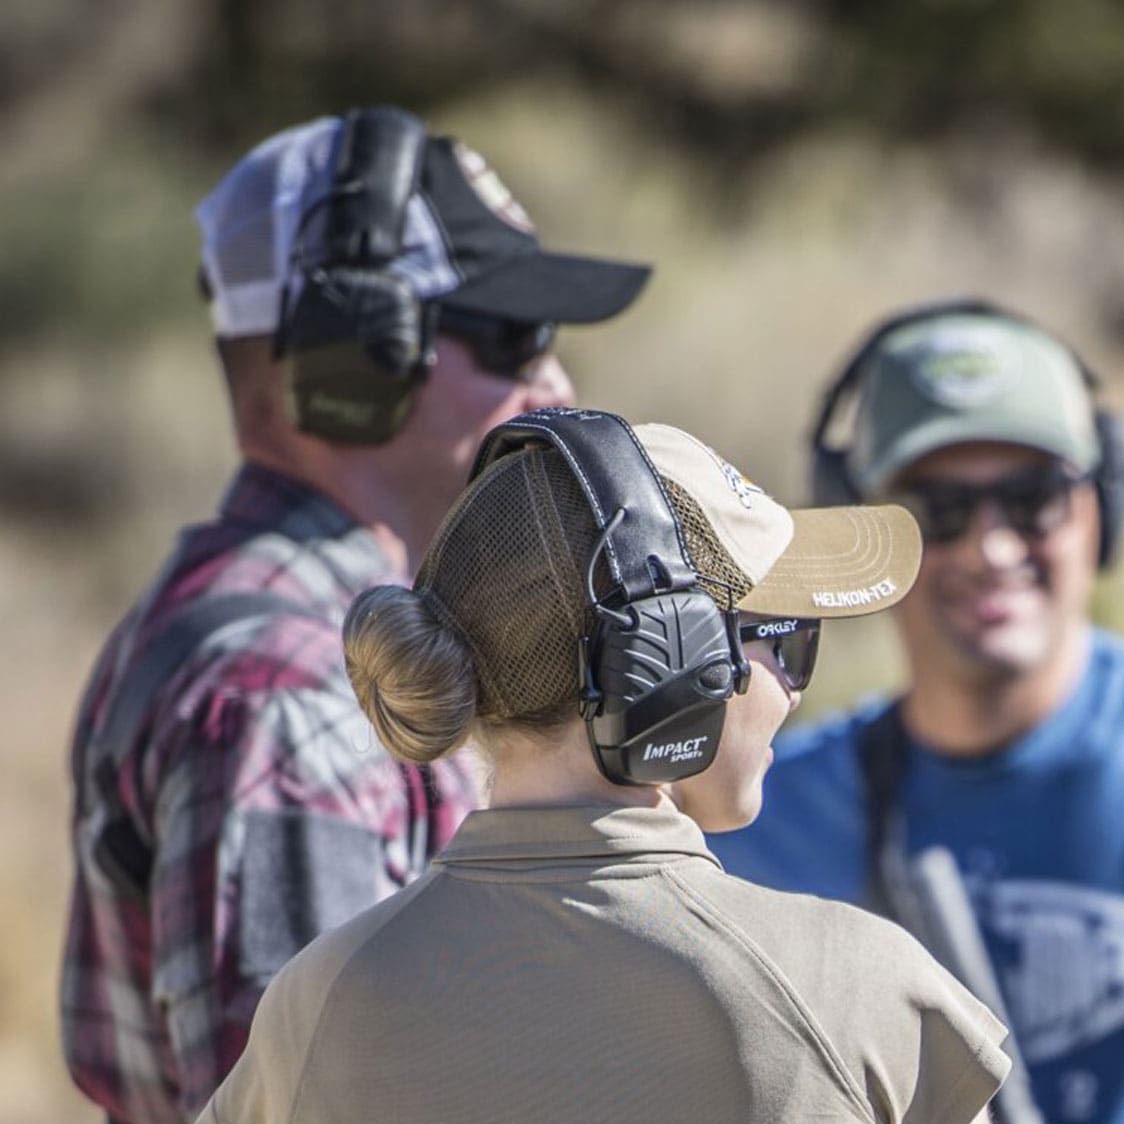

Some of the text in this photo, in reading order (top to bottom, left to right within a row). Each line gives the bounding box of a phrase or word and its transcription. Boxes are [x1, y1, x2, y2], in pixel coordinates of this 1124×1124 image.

[812, 577, 896, 607] HELIKON-TEX
[757, 619, 798, 637] OAKLEY
[643, 736, 707, 760] IMPACT
